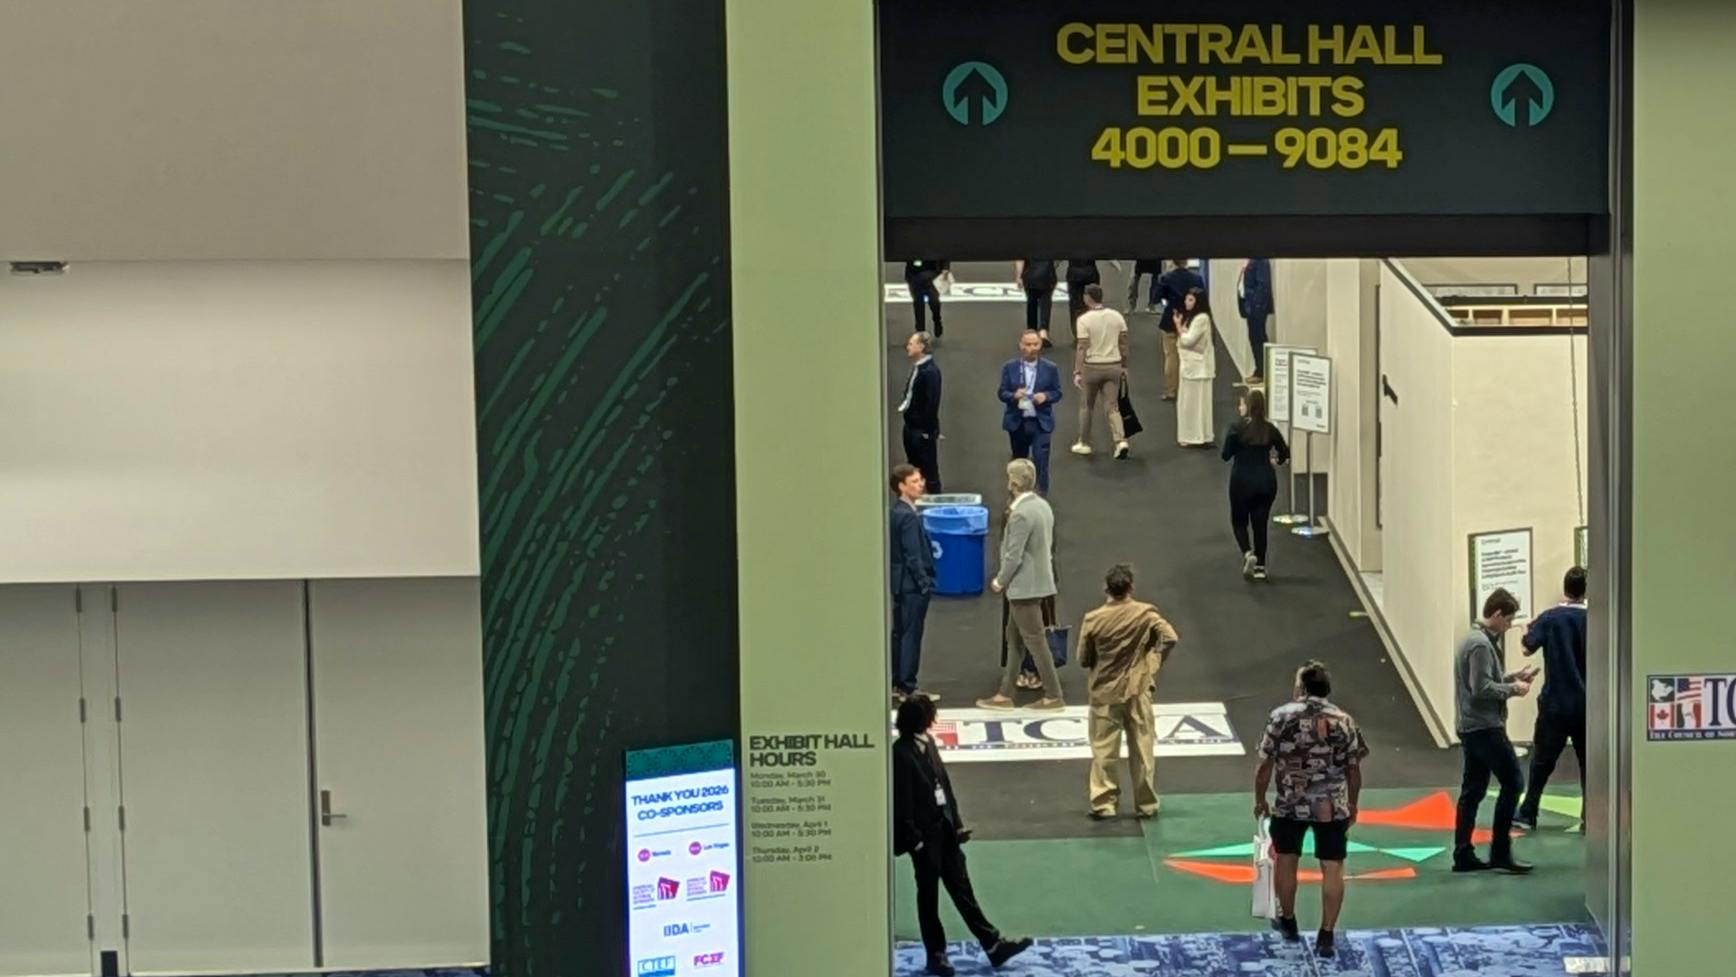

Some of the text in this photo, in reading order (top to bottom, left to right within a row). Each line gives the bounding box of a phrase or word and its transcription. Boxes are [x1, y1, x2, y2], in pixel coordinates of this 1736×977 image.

[1056, 22, 1443, 66] CENTRAL HALL
[1136, 75, 1366, 118] EXHIBITS
[963, 714, 1233, 744] TCA
[749, 733, 875, 750] EXHIBIT HALL
[749, 751, 817, 767] HOURS
[631, 784, 730, 806] THANK YOU 2026
[637, 800, 724, 821] CO-SPONSORS
